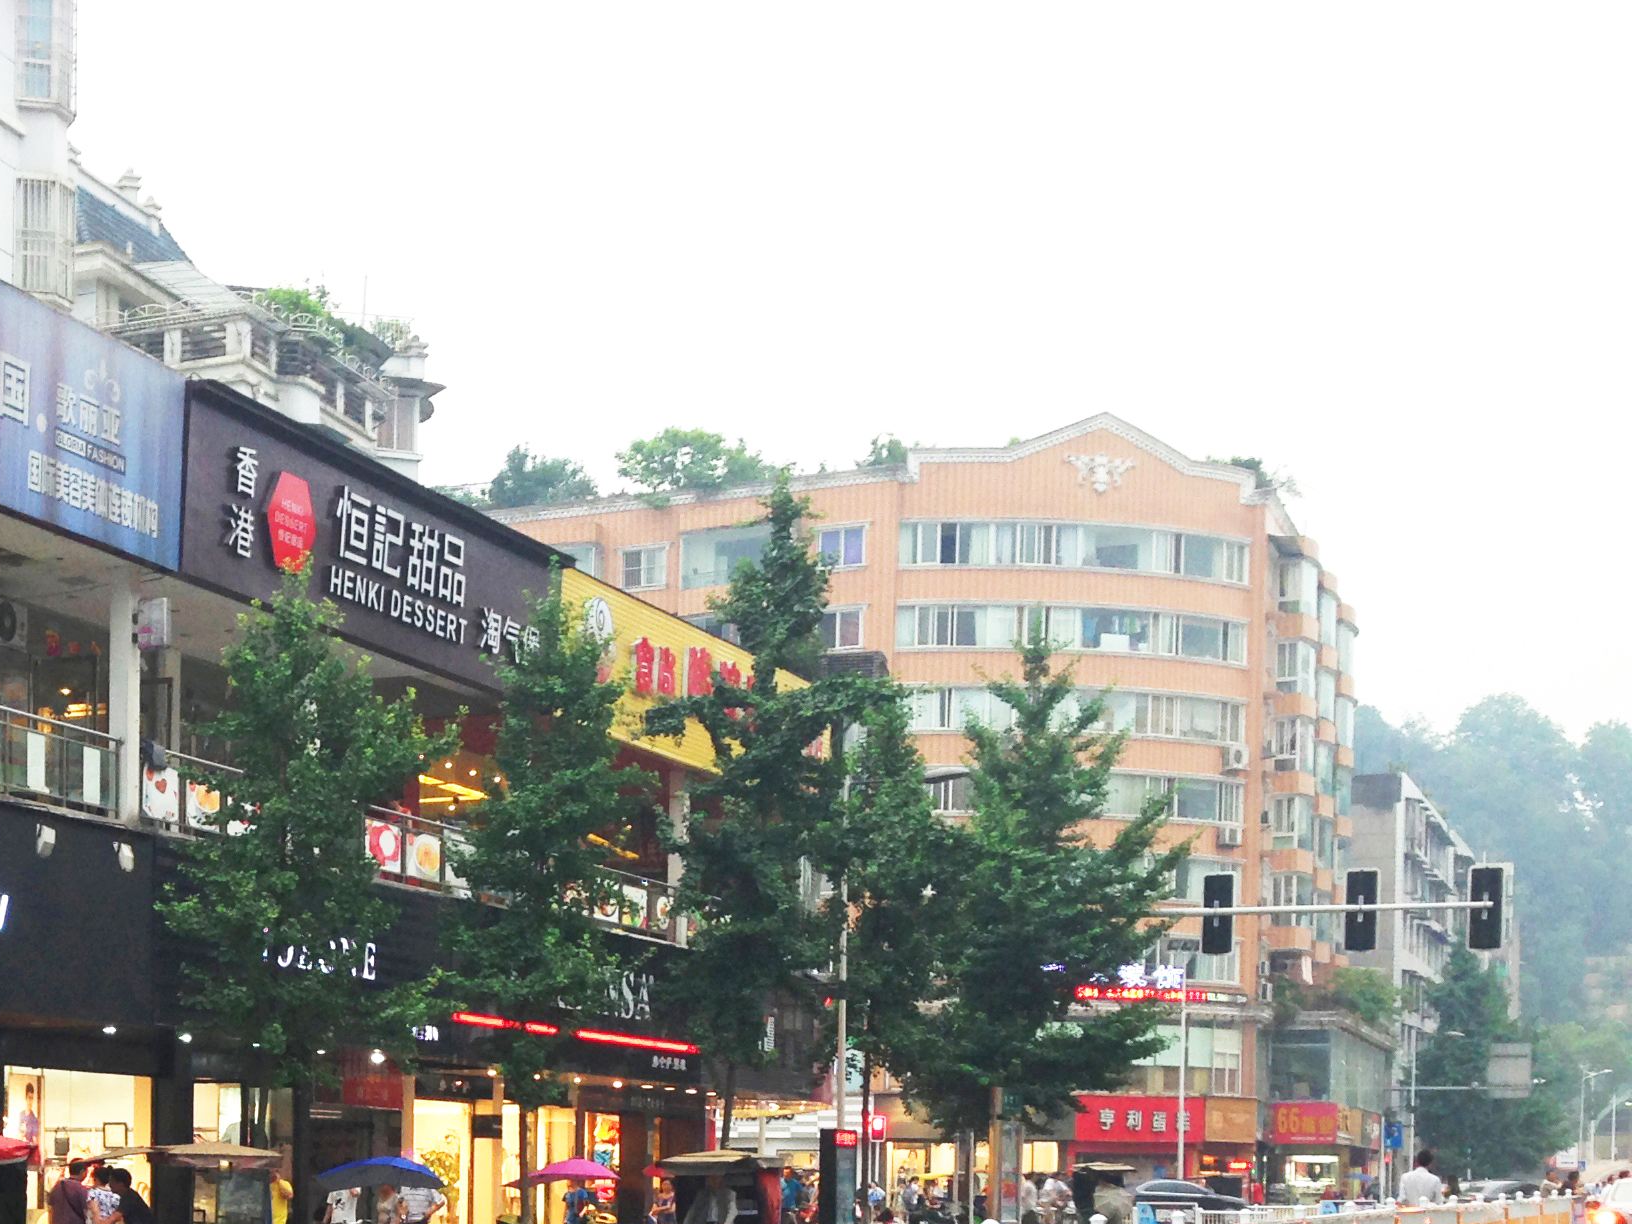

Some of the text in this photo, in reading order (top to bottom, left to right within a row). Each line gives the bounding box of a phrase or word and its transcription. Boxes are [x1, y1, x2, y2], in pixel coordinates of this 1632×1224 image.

[87, 444, 126, 474] FASHION
[229, 446, 258, 559] 香港
[330, 565, 468, 645] HENKI DESSERT
